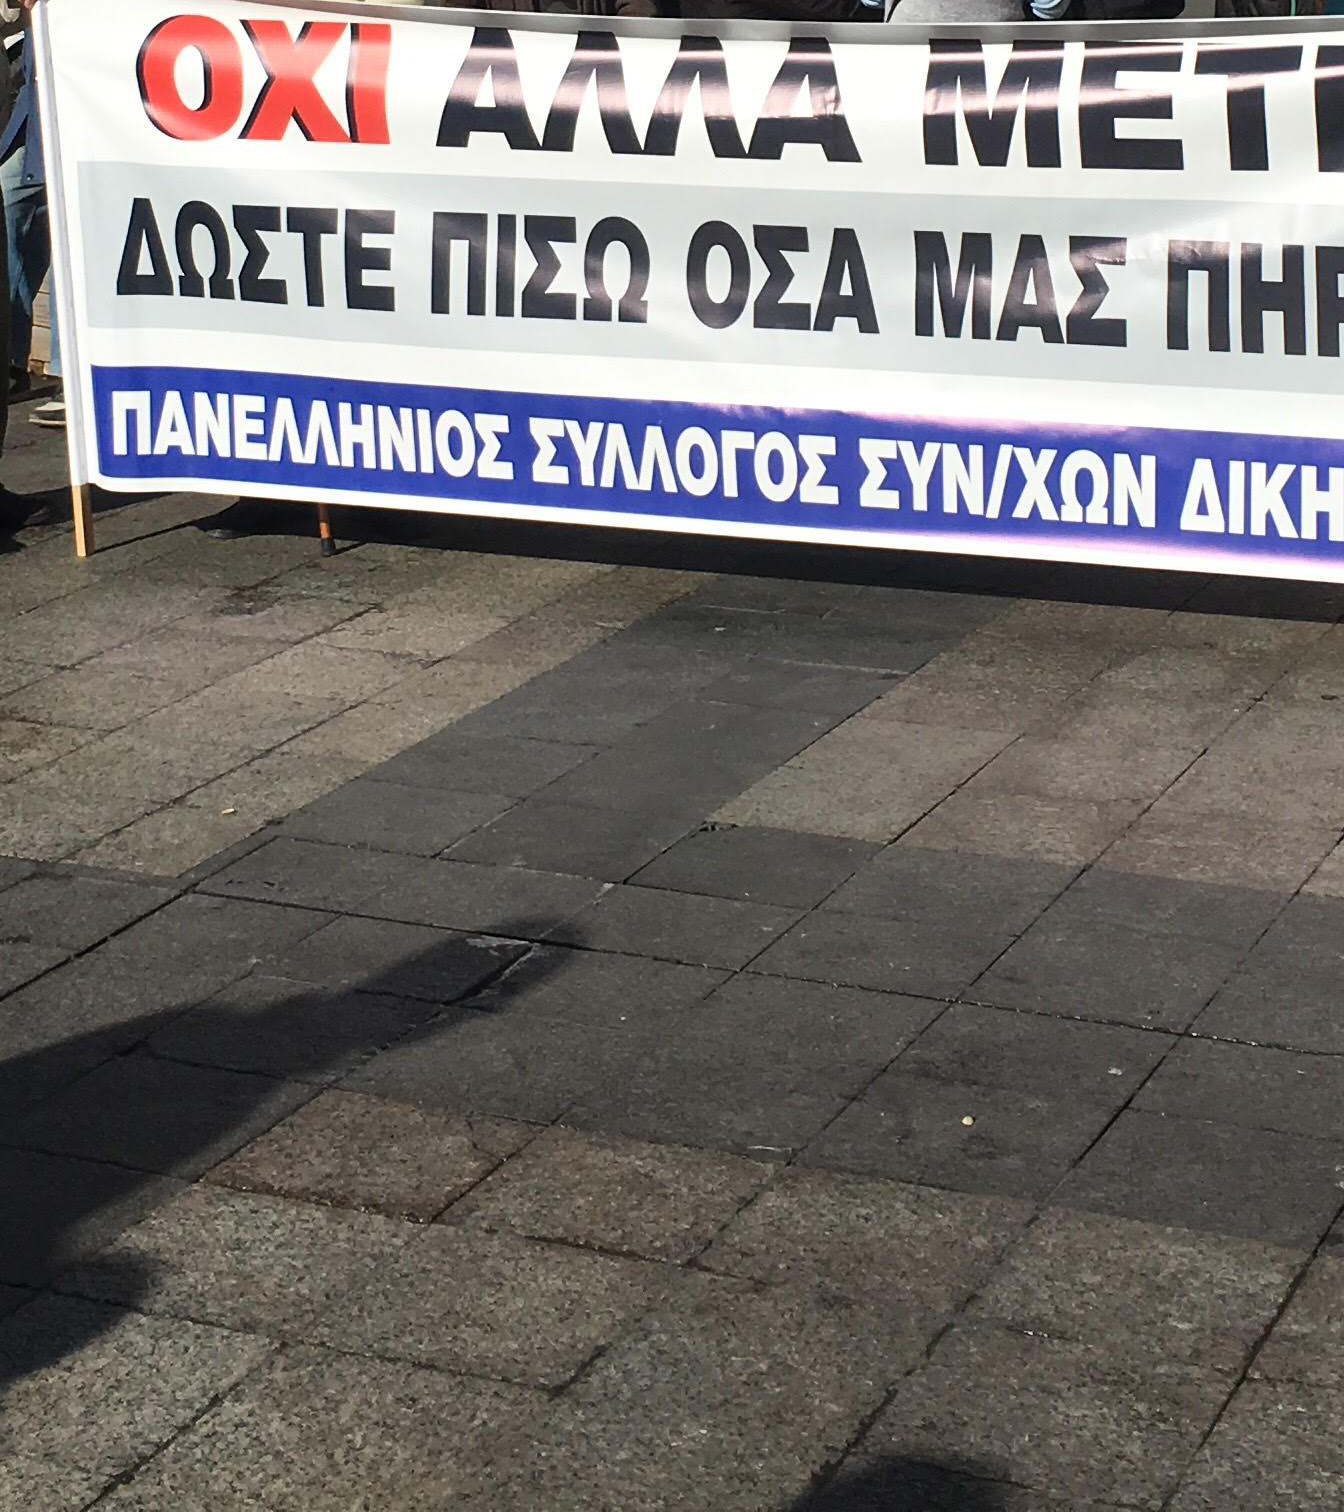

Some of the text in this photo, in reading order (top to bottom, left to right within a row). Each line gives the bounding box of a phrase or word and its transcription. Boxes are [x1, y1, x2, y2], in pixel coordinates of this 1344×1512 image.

[135, 14, 392, 145] ΟΧΙ
[436, 27, 863, 163] ΑΛΛΑ
[115, 197, 396, 313] ΔΩΣΤΕ
[429, 211, 651, 325] ΠΙΣΩ
[685, 219, 880, 335] ΟΣΑ
[912, 230, 1128, 348] ΜΑΣ
[110, 388, 514, 481] ΠΑΝΕΛΛΗΝΙΟΣ
[532, 416, 841, 506] ΣΥΛΛΟΓΟΣ
[858, 437, 1158, 529] ΣΥΝ/ΧΩΝ
